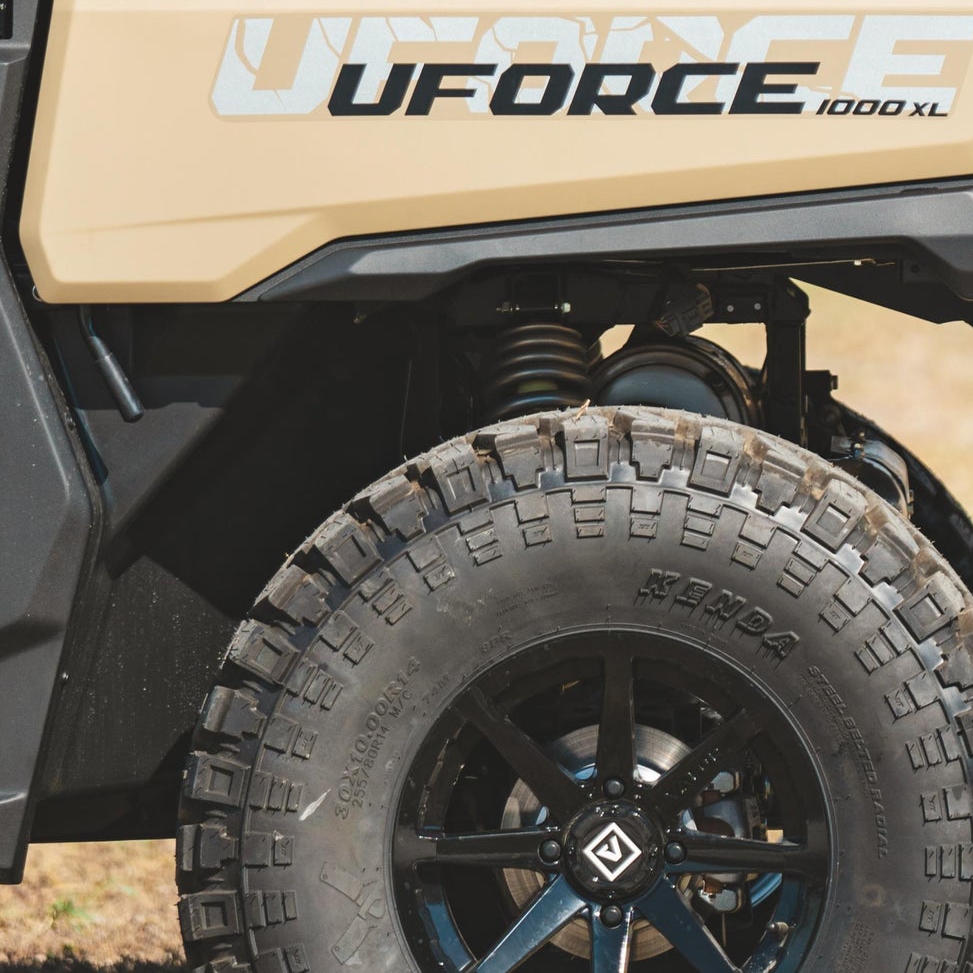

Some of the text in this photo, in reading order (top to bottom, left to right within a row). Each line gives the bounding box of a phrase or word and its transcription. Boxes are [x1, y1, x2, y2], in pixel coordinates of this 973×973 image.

[328, 62, 948, 117] UFORCE 1000 XL
[637, 567, 801, 661] KENDA
[352, 726, 390, 809] 255/80R14
[389, 690, 413, 720] M/C
[808, 665, 848, 715] STEEL
[844, 716, 878, 784] BELTED
[870, 788, 888, 859] RADIAL
